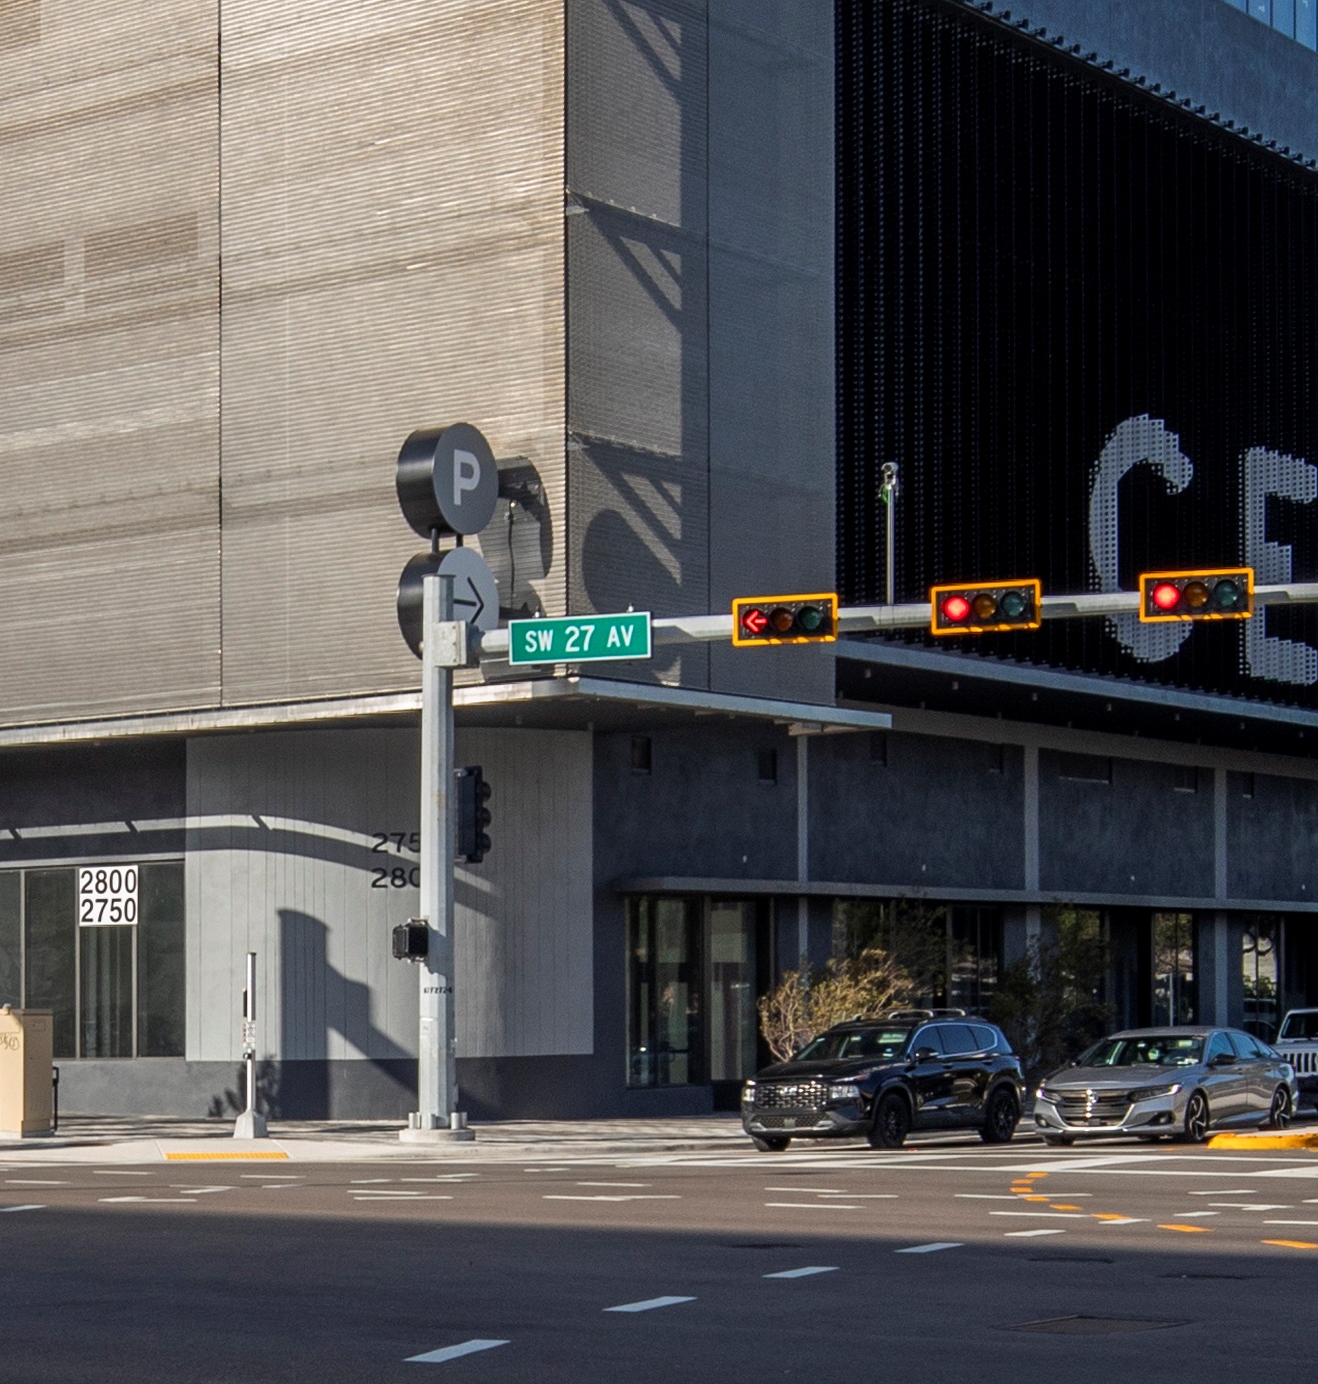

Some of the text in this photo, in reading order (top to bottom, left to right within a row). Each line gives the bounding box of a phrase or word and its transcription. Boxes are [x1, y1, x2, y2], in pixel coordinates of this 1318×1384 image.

[453, 449, 480, 506] P
[525, 625, 634, 652] SW 27 AV
[371, 833, 421, 853] 275
[81, 869, 137, 894] 2800
[371, 867, 421, 888] 280
[81, 898, 136, 922] 2750
